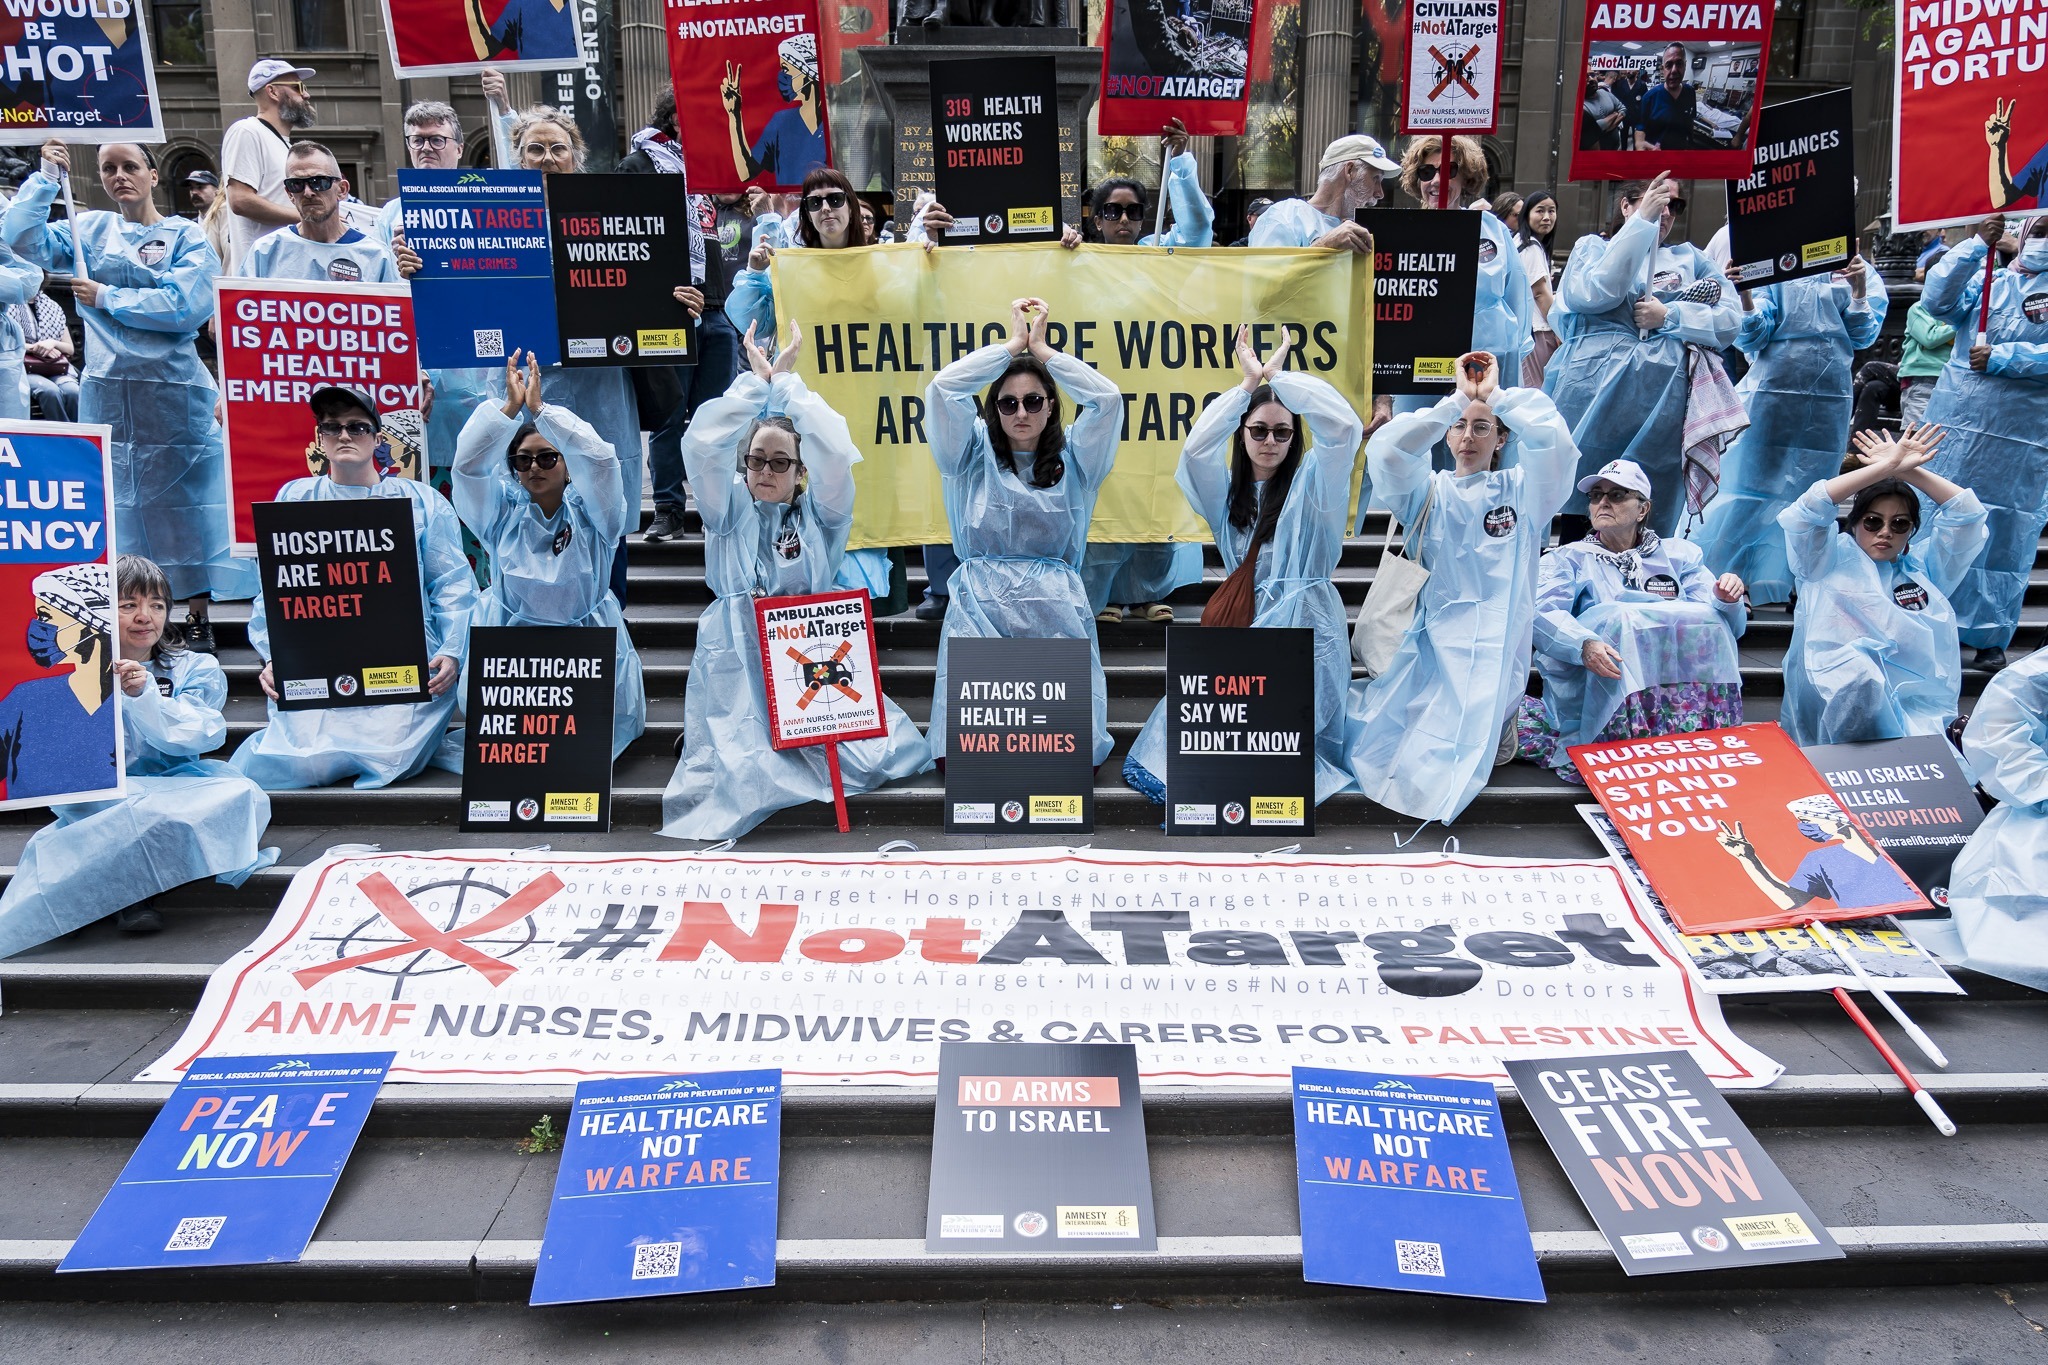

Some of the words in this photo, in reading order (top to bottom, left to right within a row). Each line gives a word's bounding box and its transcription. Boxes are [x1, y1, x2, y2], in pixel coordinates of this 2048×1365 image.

[3, 0, 131, 18] WOULD
[1416, 3, 1497, 17] CIVILIANS
[1591, 4, 1655, 29] ABU
[1662, 4, 1762, 29] SAFIYA
[24, 22, 57, 40] BE
[678, 14, 805, 39] #NOTATARGET
[1413, 19, 1497, 38] #NotATarget
[0, 45, 113, 81] HOT
[583, 32, 601, 100] OPEN
[1591, 55, 1657, 70] #NotATarget
[1107, 75, 1245, 98] #NOTATARGET
[946, 98, 971, 117] 319
[984, 95, 1042, 116] HEALTH
[904, 126, 921, 136] BY
[945, 122, 1023, 143] WORKERS
[901, 142, 915, 151] TO
[913, 157, 926, 167] OF
[948, 147, 1023, 168] DETAINED
[1737, 170, 1766, 192] ARE
[1772, 162, 1801, 184] NOT
[1806, 160, 1816, 177] A
[481, 186, 518, 194] PREVENTION
[1737, 188, 1795, 215] TARGET
[405, 208, 545, 229] #NOTATARGET
[560, 217, 600, 236] 1055
[602, 216, 665, 235] HEALTH
[1012, 212, 1036, 220] AMNESTY
[408, 237, 457, 249] ATTACKS
[459, 237, 475, 249] ON
[478, 237, 546, 249] HEALTHCARE
[566, 242, 651, 262] WORKERS
[1806, 244, 1830, 254] AMNESTY
[451, 258, 476, 270] WAR
[478, 257, 518, 269] CRIMES
[1398, 253, 1456, 271] HEALTH
[569, 268, 627, 287] KILLED
[236, 299, 401, 327] GENOCIDE
[232, 326, 261, 348] IS
[268, 328, 289, 349] A
[296, 328, 409, 353] PUBLIC
[263, 354, 381, 379] HEALTH
[0, 479, 86, 510] LUE
[272, 528, 395, 556] HOSPITALS
[277, 563, 321, 588] ARE
[327, 561, 370, 586] NOT
[378, 561, 392, 584] A
[279, 594, 363, 620] TARGET
[767, 603, 862, 622] AMBULANCES
[768, 619, 866, 640] #NotATarget
[368, 671, 398, 680] AMNESTY
[483, 657, 602, 679] HEALTHCARE
[959, 681, 1036, 700] ATTACKS
[1042, 682, 1066, 701] ON
[1180, 675, 1208, 695] WE
[1214, 675, 1267, 696] CAN'T
[481, 686, 574, 707] WORKERS
[783, 717, 805, 726] ANMF
[806, 714, 836, 724] NURSES,
[838, 709, 875, 720] MIDWIVES
[960, 707, 1026, 726] HEALTH
[1032, 715, 1047, 724] =
[1180, 703, 1214, 723] SAY
[1219, 703, 1248, 723] WE
[479, 714, 517, 735] ARE
[522, 714, 560, 735] NOT
[564, 714, 577, 735] A
[794, 726, 821, 735] CARERS
[822, 723, 837, 731] FOR
[838, 719, 874, 729] PALESTINE
[959, 733, 1000, 752] WAR
[1006, 733, 1076, 753] CRIMES
[1180, 730, 1242, 751] DIDN'T
[1247, 731, 1300, 751] KNOW
[1582, 738, 1717, 766] NURSES
[1721, 735, 1750, 749] &
[478, 743, 550, 763] TARGET
[1593, 752, 1763, 783] MIDWIVES
[1825, 770, 1863, 787] END
[1865, 763, 1944, 784] ISRAEL'S
[1605, 773, 1737, 802] STAND
[550, 798, 579, 806] AMNESTY
[1615, 793, 1728, 821] WITH
[1627, 815, 1717, 841] YOU
[557, 901, 1660, 997] #NotATarget
[246, 1001, 416, 1036] ANMF
[425, 1003, 665, 1045] NURSES,
[684, 1012, 971, 1043] MIDWIVES
[987, 1020, 1024, 1043] &
[1040, 1022, 1261, 1045] CARERS
[1278, 1024, 1391, 1045] FOR
[1401, 1025, 1697, 1047] PALESTINE
[188, 1073, 224, 1081] MEDICAL
[225, 1071, 279, 1080] ASSOCIATION
[280, 1070, 297, 1079] FOR
[298, 1069, 350, 1078] PREVENTION
[351, 1068, 362, 1076] OF
[362, 1067, 383, 1076] WAR
[1537, 1063, 1692, 1105] CEASE
[580, 1096, 616, 1106] MEDICAL
[617, 1092, 672, 1103] ASSOCIATION
[673, 1091, 690, 1099] FOR
[690, 1087, 743, 1098] PREVENTION
[743, 1086, 755, 1095] OF
[756, 1085, 776, 1094] WAR
[964, 1080, 1002, 1102] NO
[1011, 1081, 1092, 1103] ARMS
[1299, 1083, 1334, 1093] MEDICAL
[1335, 1087, 1389, 1098] ASSOCIATION
[1390, 1091, 1406, 1099] FOR
[1408, 1093, 1459, 1104] PREVENTION
[1460, 1097, 1471, 1105] OF
[1472, 1098, 1492, 1107] WAR
[580, 1103, 769, 1137] HEALTHCARE
[962, 1109, 997, 1132] TO
[1009, 1110, 1111, 1133] ISRAEL
[1307, 1101, 1494, 1138] HEALTHCARE
[1558, 1098, 1732, 1157] FIRE
[176, 1130, 310, 1171] NOW
[641, 1133, 703, 1160] NOT
[1372, 1133, 1431, 1159] NOT
[585, 1157, 752, 1192] WARFARE
[1324, 1156, 1492, 1192] WARFARE
[1590, 1148, 1763, 1212] NOW
[1065, 1211, 1107, 1220] AMNESTY
[1735, 1221, 1777, 1232] AMNESTY
[1741, 1229, 1782, 1238] INTERNATIONAL
